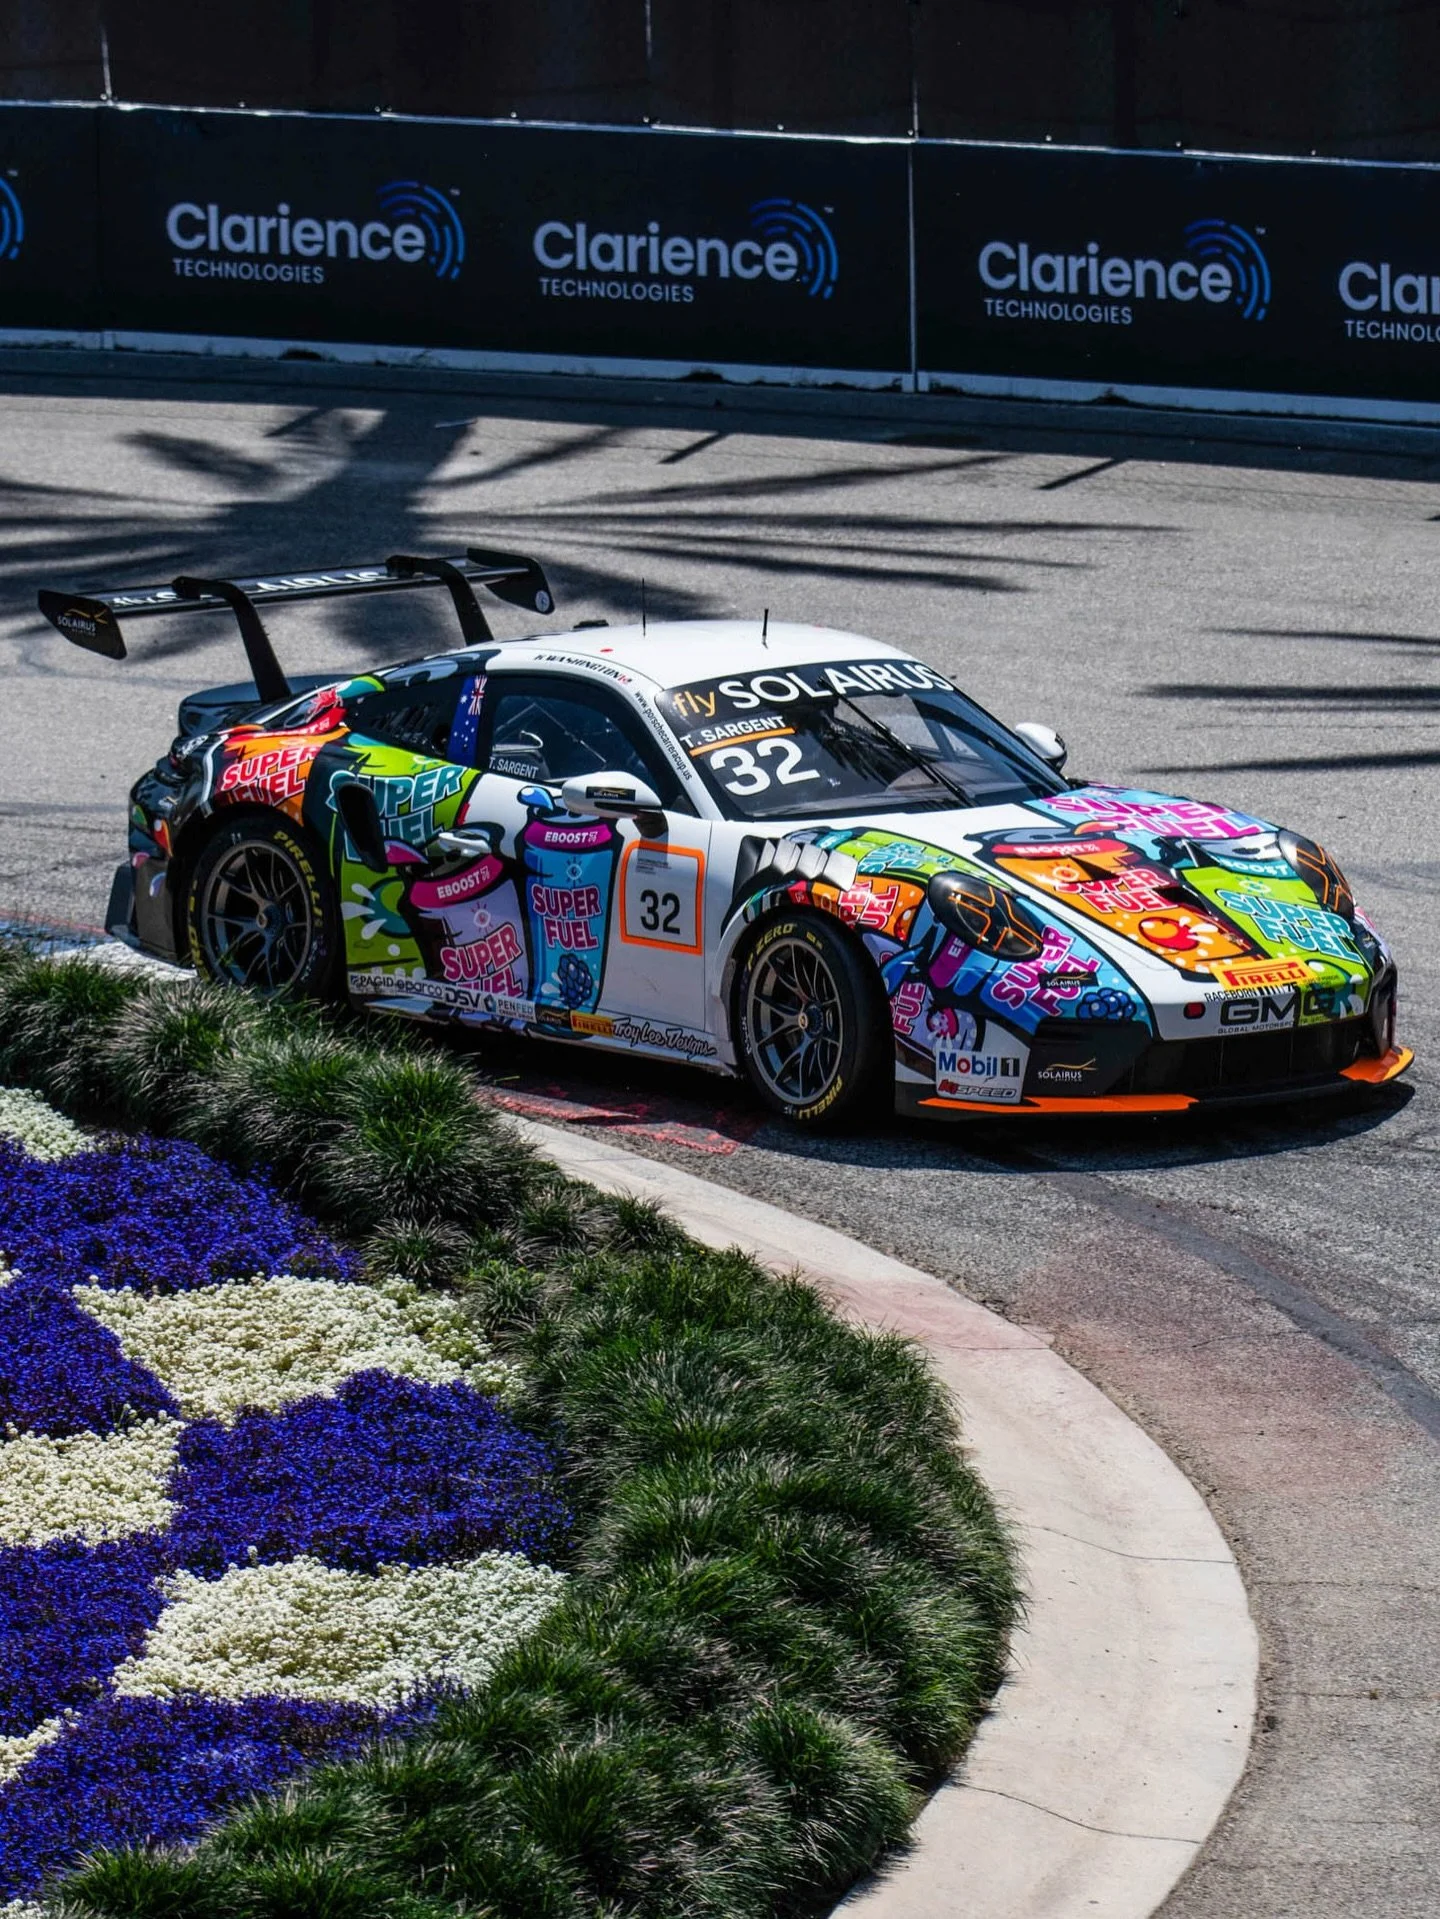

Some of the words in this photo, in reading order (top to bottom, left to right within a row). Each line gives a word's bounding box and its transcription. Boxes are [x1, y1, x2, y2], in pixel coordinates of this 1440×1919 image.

[166, 203, 426, 262] Clarience
[533, 221, 799, 281] Clarience
[172, 258, 325, 284] TECHNOLOGIES
[979, 241, 1233, 303] Clarience
[539, 278, 695, 303] TECHNOLOGIES
[984, 299, 1133, 325] TECHNOLOGIES
[57, 615, 96, 632] SOLAIRUS
[671, 689, 716, 718] fly
[718, 663, 954, 709] SOLAIRUS
[704, 716, 785, 742] SARGENT
[221, 746, 320, 791] SUPER
[488, 756, 497, 769] T.
[497, 758, 539, 779] SARGENT
[710, 737, 821, 797] 32
[544, 831, 588, 842] EBOOST
[273, 829, 323, 921] PIRELLI
[437, 871, 480, 899] EBOOST
[531, 883, 602, 919] SUPER
[640, 889, 681, 935] 32
[1215, 888, 1355, 940] SUPER
[543, 918, 600, 950] FUEL
[755, 922, 798, 953] ZERO
[1250, 913, 1366, 964] FUEL
[439, 924, 523, 983] SUPER
[991, 925, 1074, 1009] SUPER
[360, 974, 394, 988] PAGID
[1222, 962, 1308, 987] PIRELLI
[444, 986, 481, 1009] DSV
[498, 1000, 535, 1014] PENFED
[893, 981, 926, 1035] FUE
[1204, 987, 1257, 1002] RACEBORN
[612, 1016, 641, 1048] Troy
[640, 1021, 665, 1046] Lee
[665, 1027, 717, 1060] Designs
[1218, 1026, 1250, 1034] GLOBAL
[938, 1051, 997, 1077] Mobil
[1037, 1071, 1082, 1079] SOLAIRUS
[799, 1074, 844, 1120] PIRELLI
